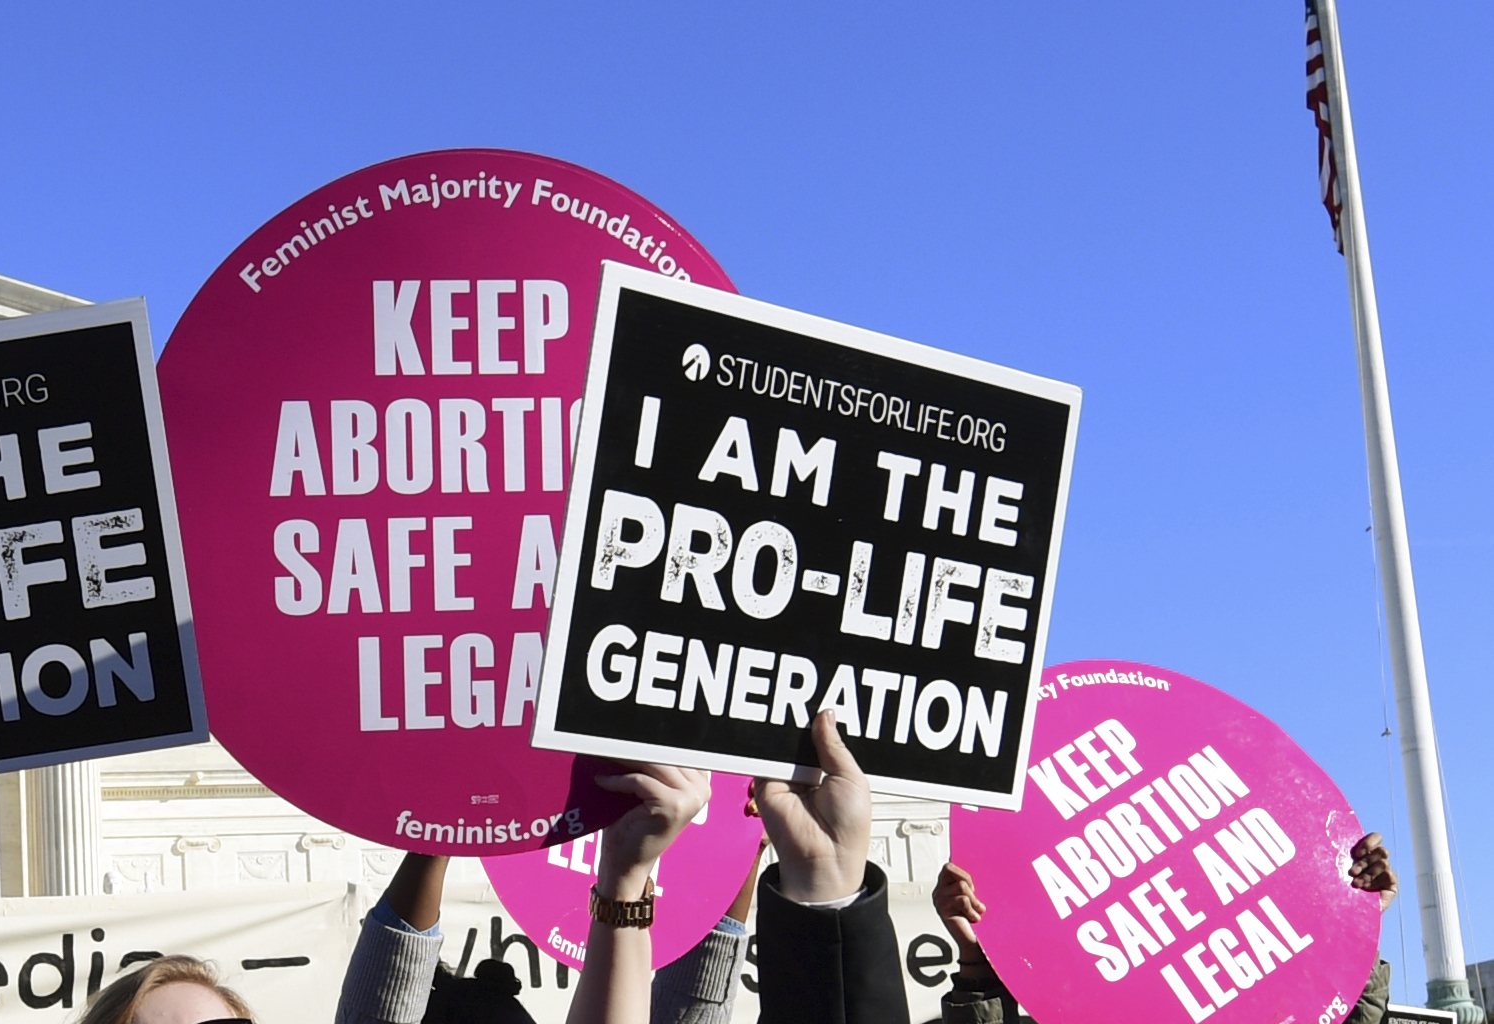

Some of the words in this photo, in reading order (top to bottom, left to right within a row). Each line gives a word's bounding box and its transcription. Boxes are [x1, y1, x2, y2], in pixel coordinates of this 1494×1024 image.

[239, 195, 374, 294] Feminist
[378, 170, 522, 209] Majority
[371, 279, 570, 376] KEEP
[269, 397, 581, 497] ABORTI
[717, 354, 1007, 453] STUDENTSFORLIFE.ORG
[634, 395, 661, 469] I
[698, 416, 837, 507] AM
[877, 451, 1024, 547] THE
[272, 516, 473, 616] SAFE
[591, 489, 1035, 665] PRO-LIFE
[358, 631, 545, 732] LEGA
[586, 624, 1008, 758] GENERATION
[1056, 668, 1170, 692] Foundation
[1027, 718, 1143, 820] KEEP
[395, 807, 584, 844] feminist.org
[1031, 745, 1250, 920] ABORTION
[1076, 866, 1207, 983] SAFE
[1191, 807, 1296, 906] AND
[1159, 895, 1314, 1024] LEGAL
